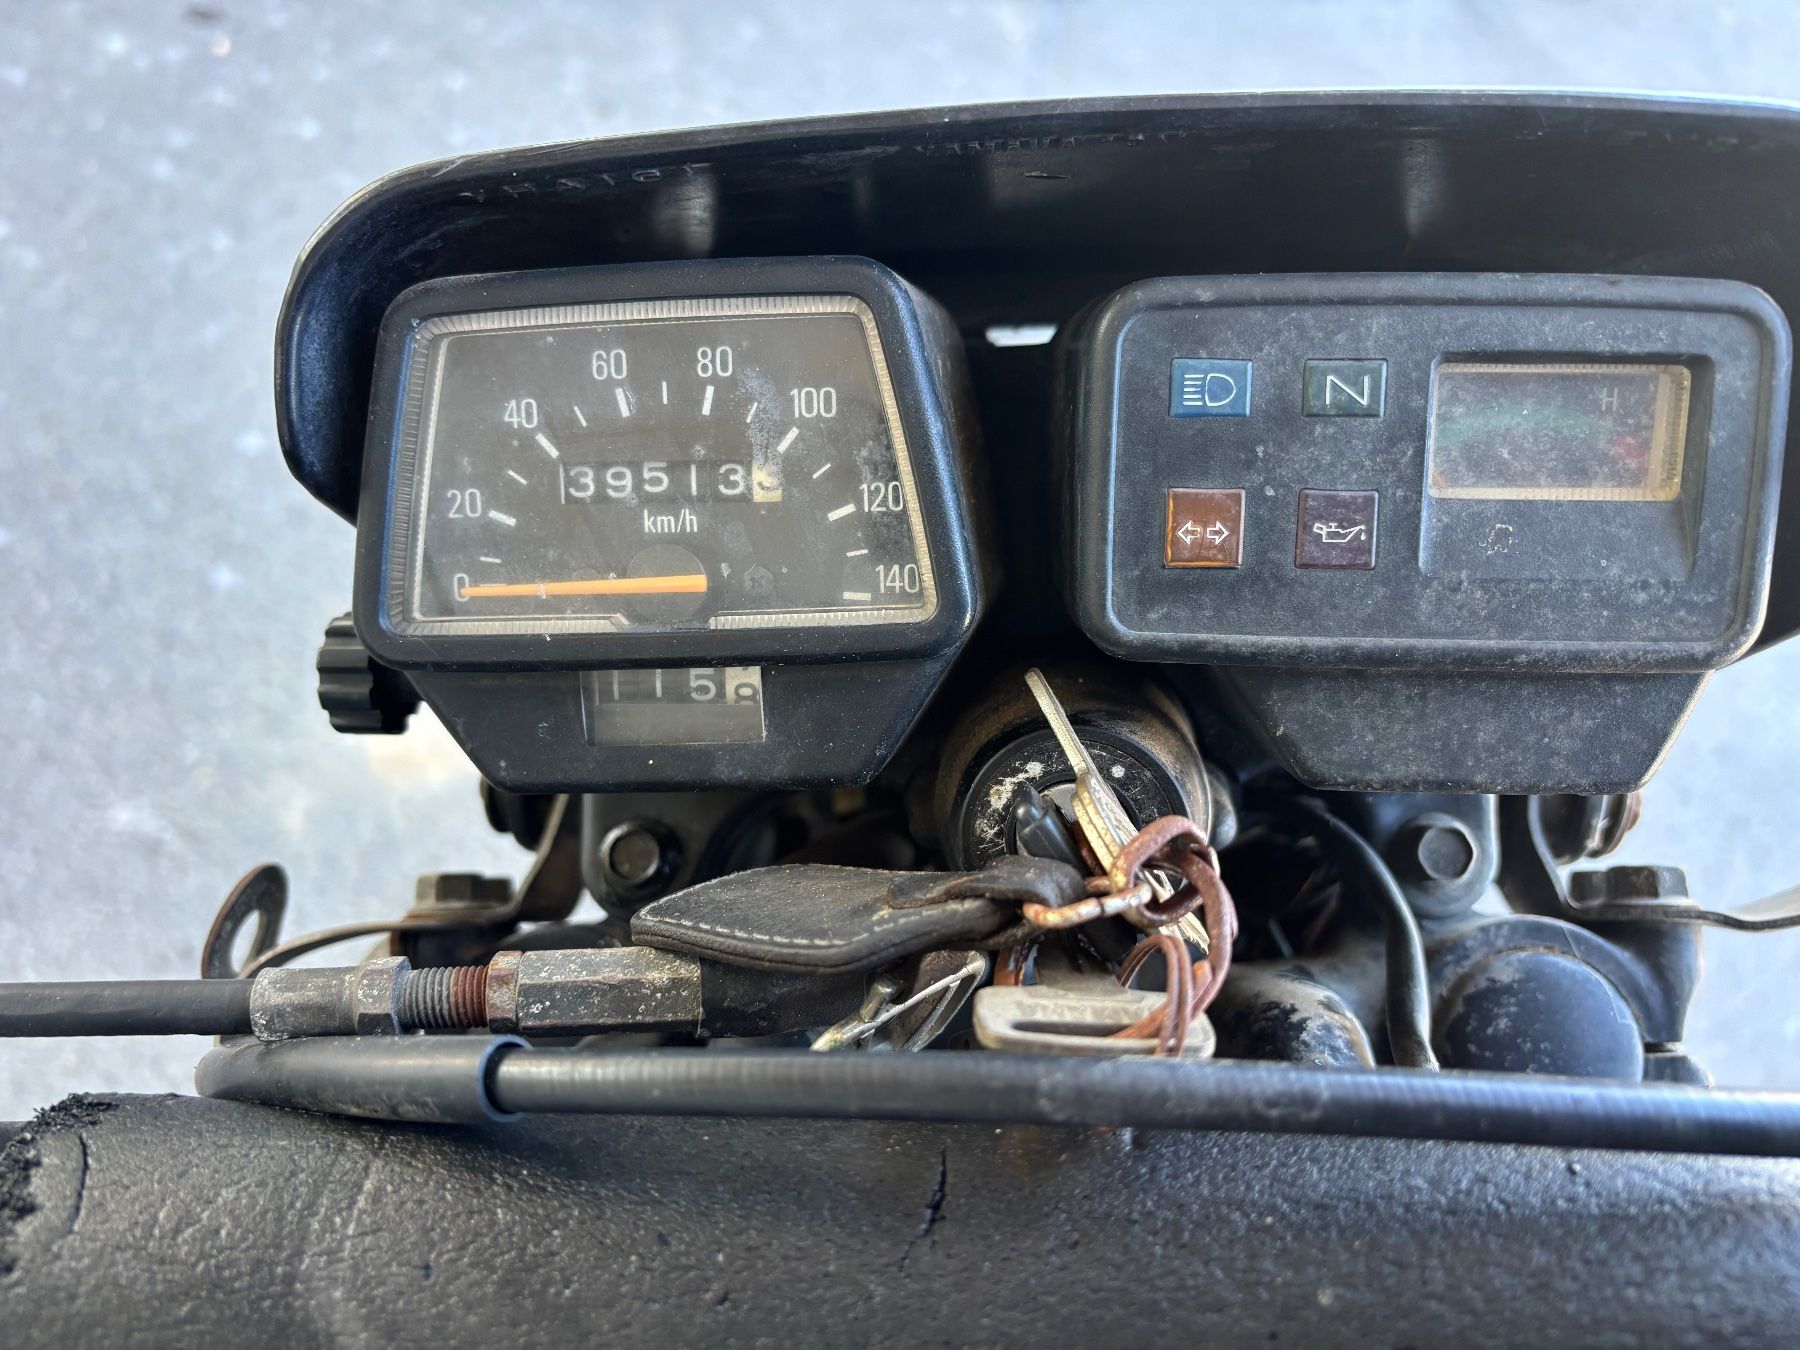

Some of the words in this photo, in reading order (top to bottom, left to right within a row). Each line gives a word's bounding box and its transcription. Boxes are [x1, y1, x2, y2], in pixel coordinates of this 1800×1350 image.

[591, 349, 628, 381] 60
[696, 346, 734, 378] 80
[789, 386, 837, 419] 100
[1325, 374, 1370, 406] N
[1600, 386, 1618, 411] H
[503, 398, 538, 430] 40
[446, 487, 482, 519] 20
[859, 481, 904, 513] 120
[643, 508, 699, 534] km/h
[453, 572, 471, 602] 0
[875, 563, 920, 594] 140
